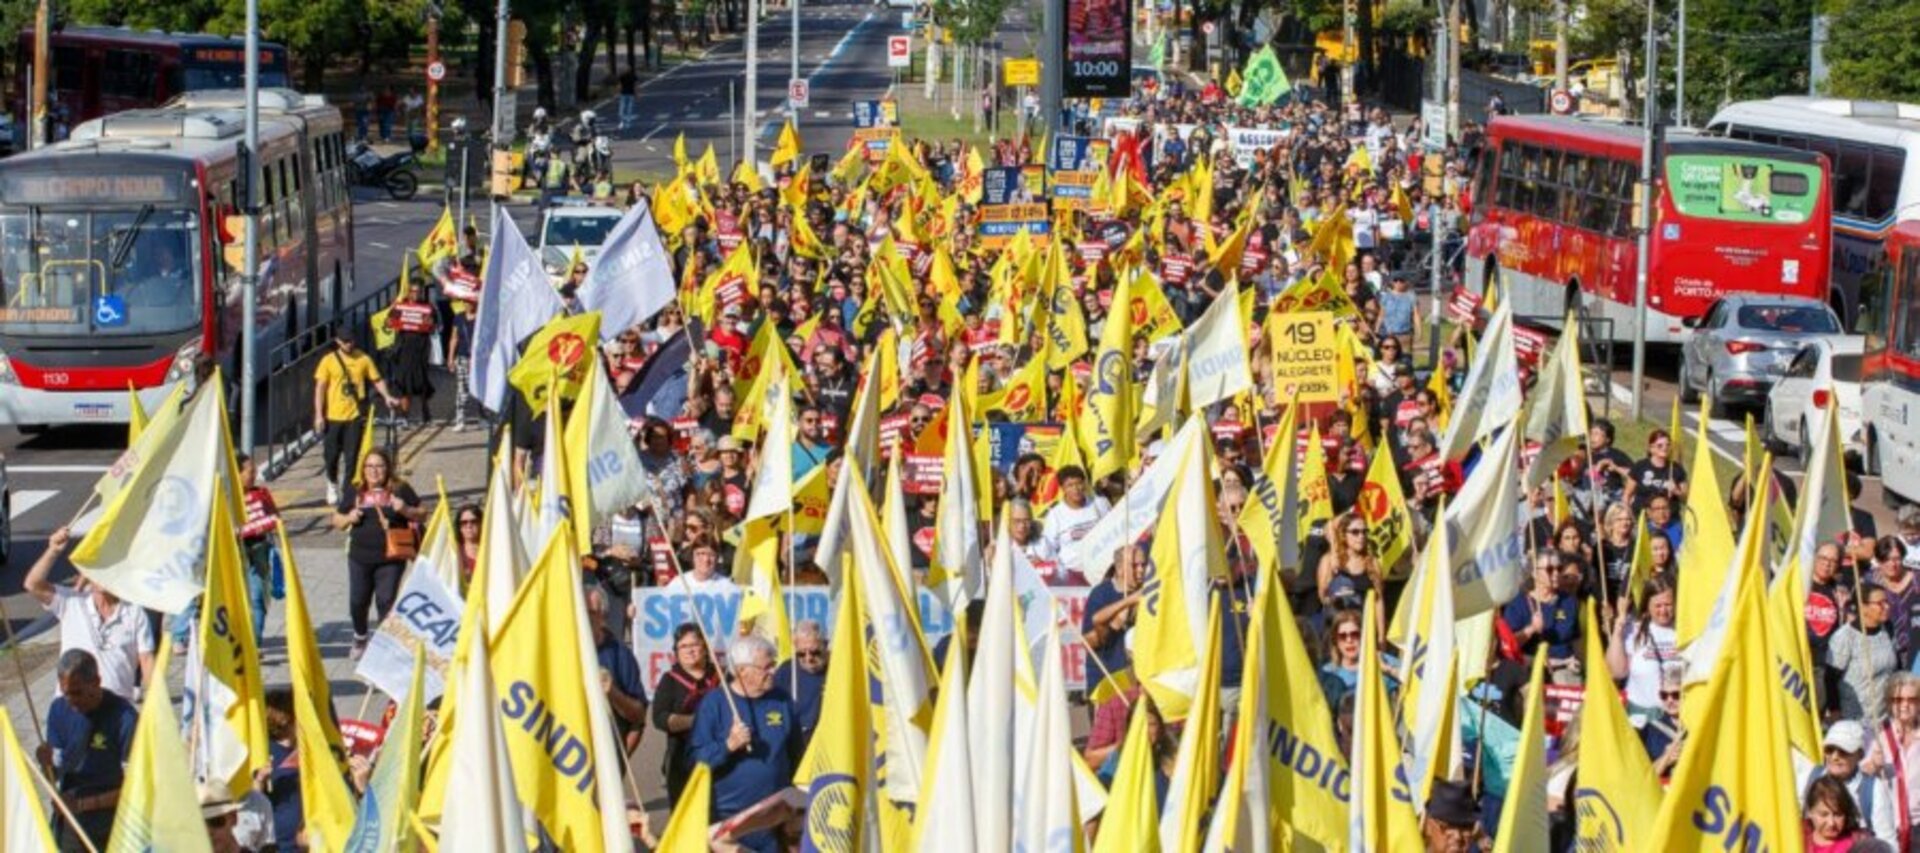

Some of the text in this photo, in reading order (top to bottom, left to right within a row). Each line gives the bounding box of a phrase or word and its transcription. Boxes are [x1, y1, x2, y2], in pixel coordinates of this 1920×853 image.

[1074, 61, 1119, 77] 10:00
[1674, 285, 1712, 297] PORTO
[1277, 347, 1334, 363] NÚCLEO
[43, 372, 70, 384] 1130
[1276, 364, 1334, 378] ALEGRETE
